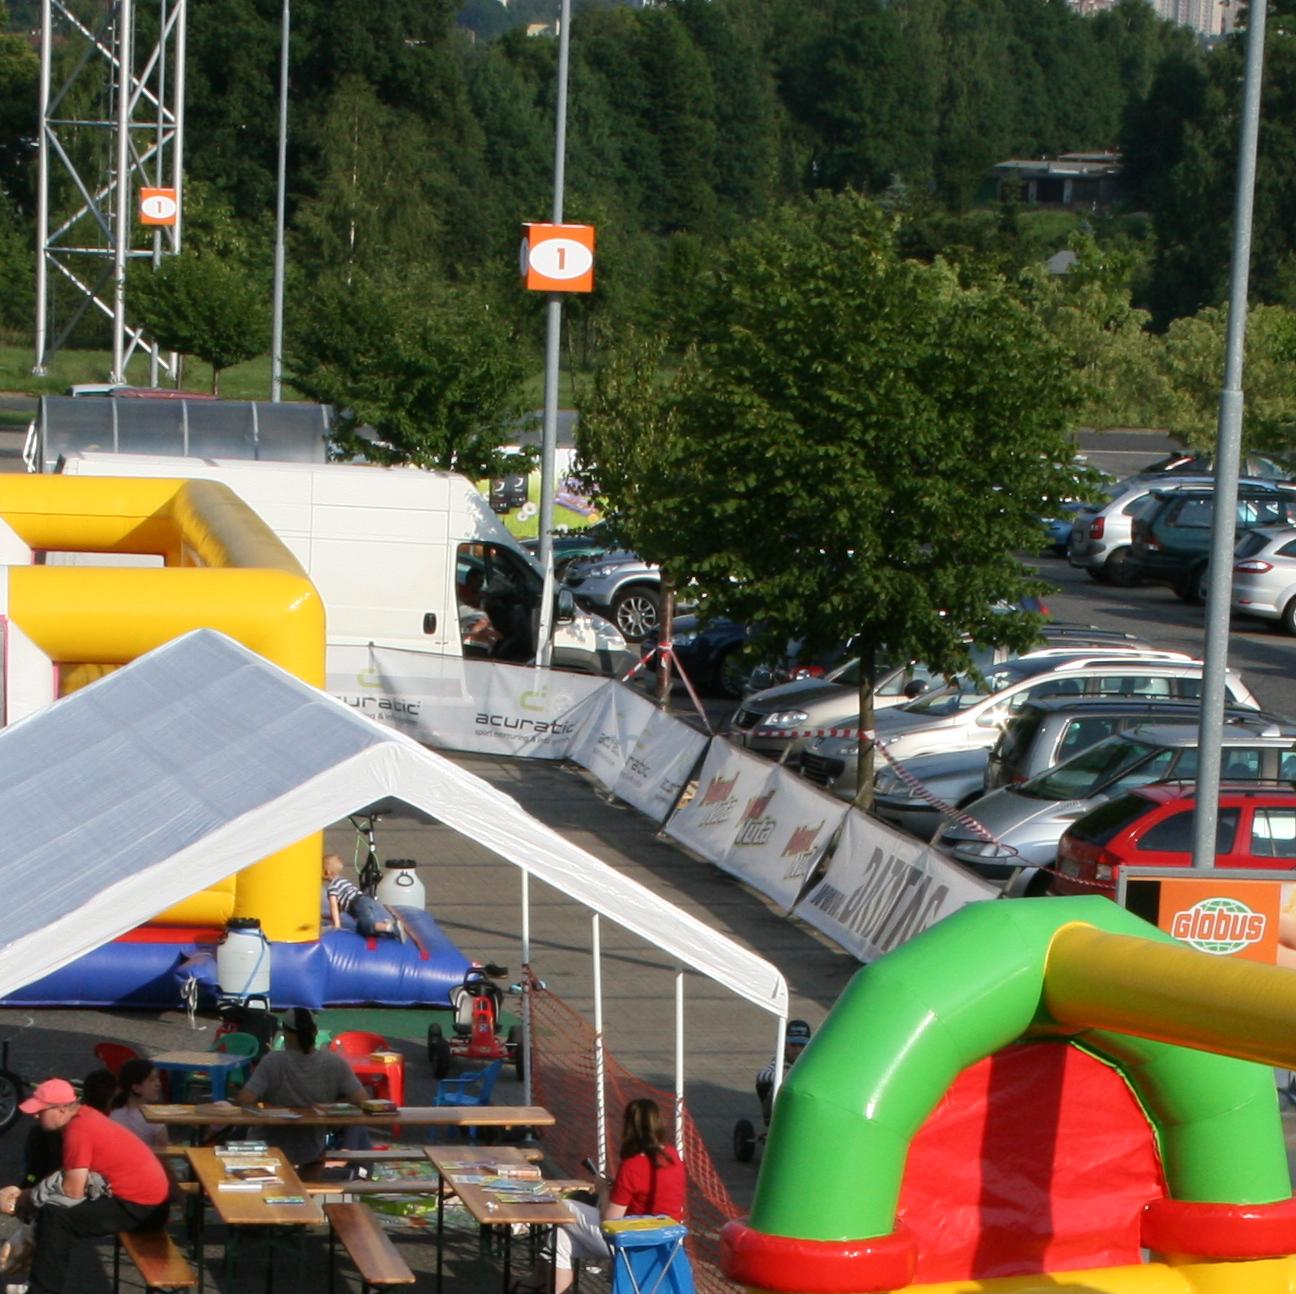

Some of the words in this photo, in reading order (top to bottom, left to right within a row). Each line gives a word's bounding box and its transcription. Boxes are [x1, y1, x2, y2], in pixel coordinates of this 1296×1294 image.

[156, 201, 162, 214] 1
[557, 247, 566, 270] 1
[475, 712, 577, 735] acuratic
[1171, 907, 1267, 944] Globus
